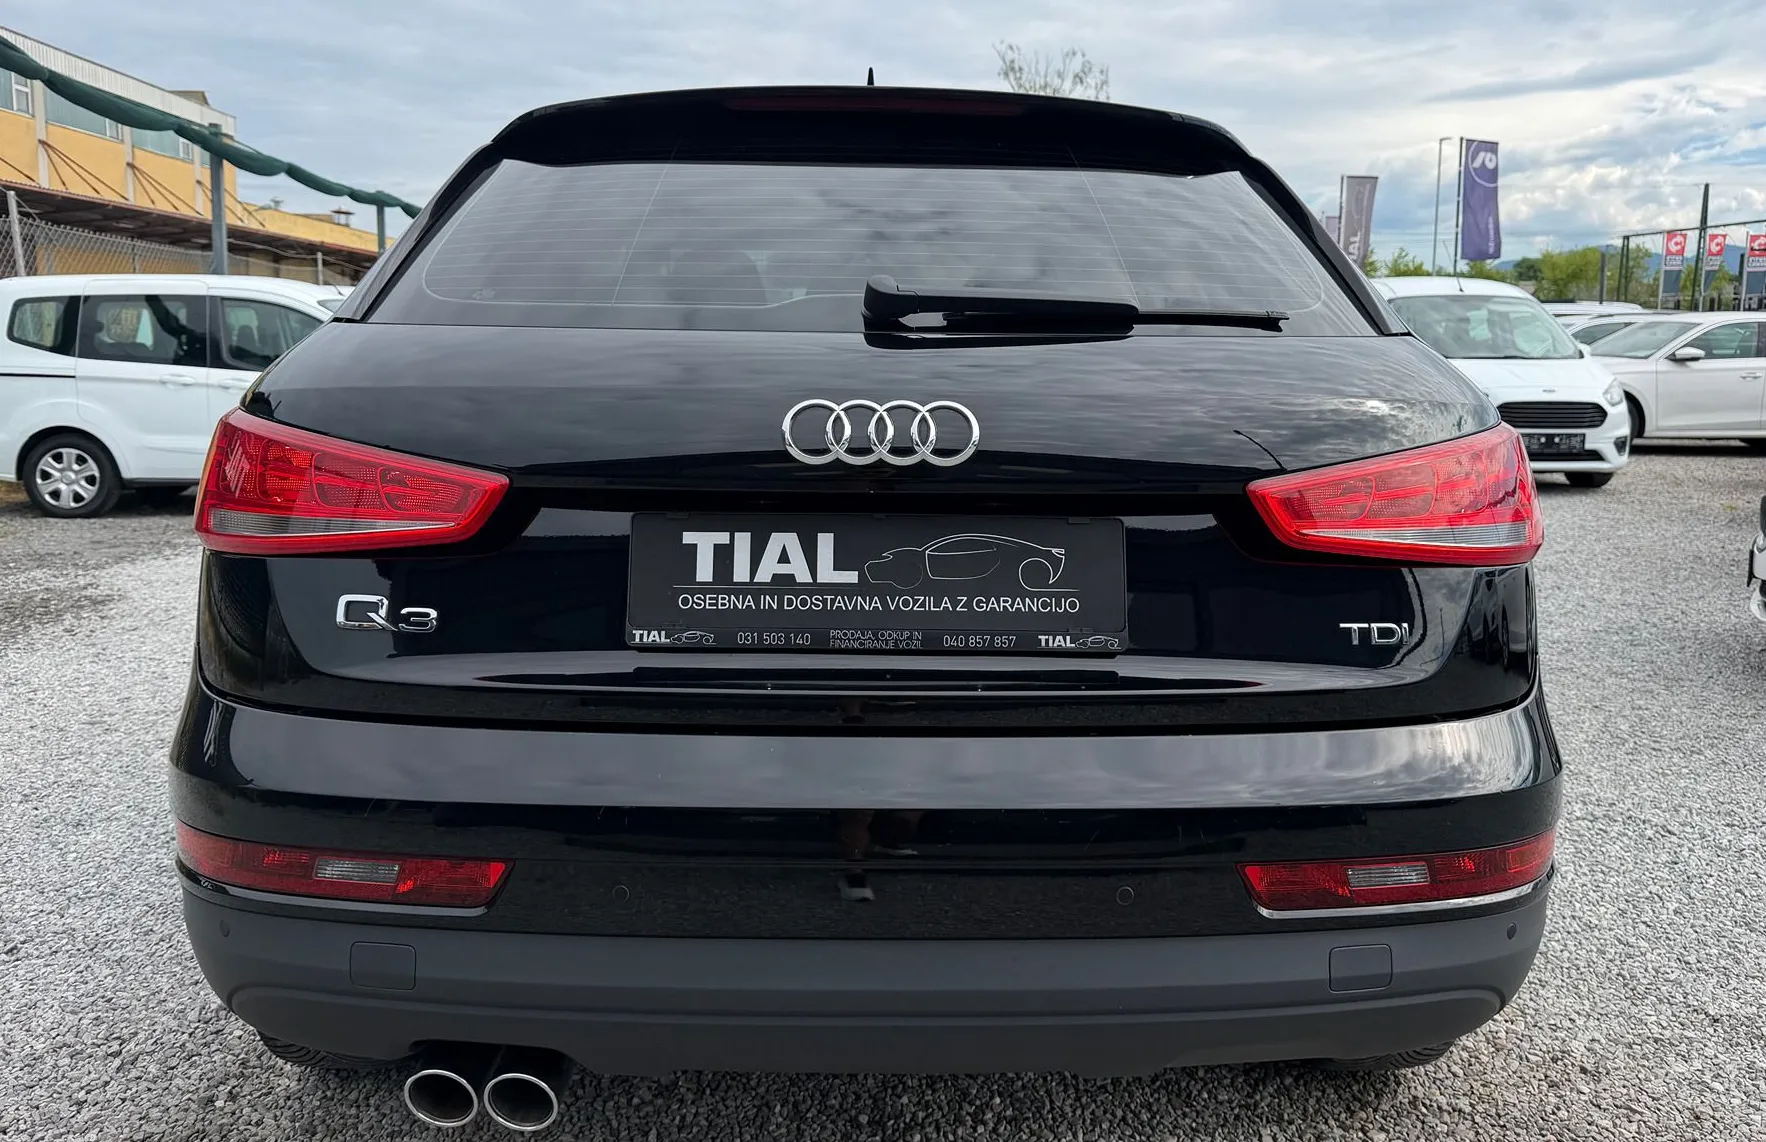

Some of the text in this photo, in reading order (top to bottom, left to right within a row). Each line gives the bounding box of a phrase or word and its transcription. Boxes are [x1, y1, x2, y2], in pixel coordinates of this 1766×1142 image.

[682, 531, 859, 583] TIAL
[678, 594, 1080, 613] OSEBNA IN DOSTAVNA VOZILA Z GARANCIJO
[336, 594, 438, 633] Q3
[633, 630, 670, 643] TIAL
[737, 632, 811, 645] 031 503 140
[829, 630, 922, 640] PRODAJA, ODKUP IN
[1339, 623, 1409, 645] TDI
[829, 639, 923, 649] FINANCIRANJE VOZIL
[943, 635, 1016, 648] 040 857 857
[1038, 635, 1075, 648] TIAL
